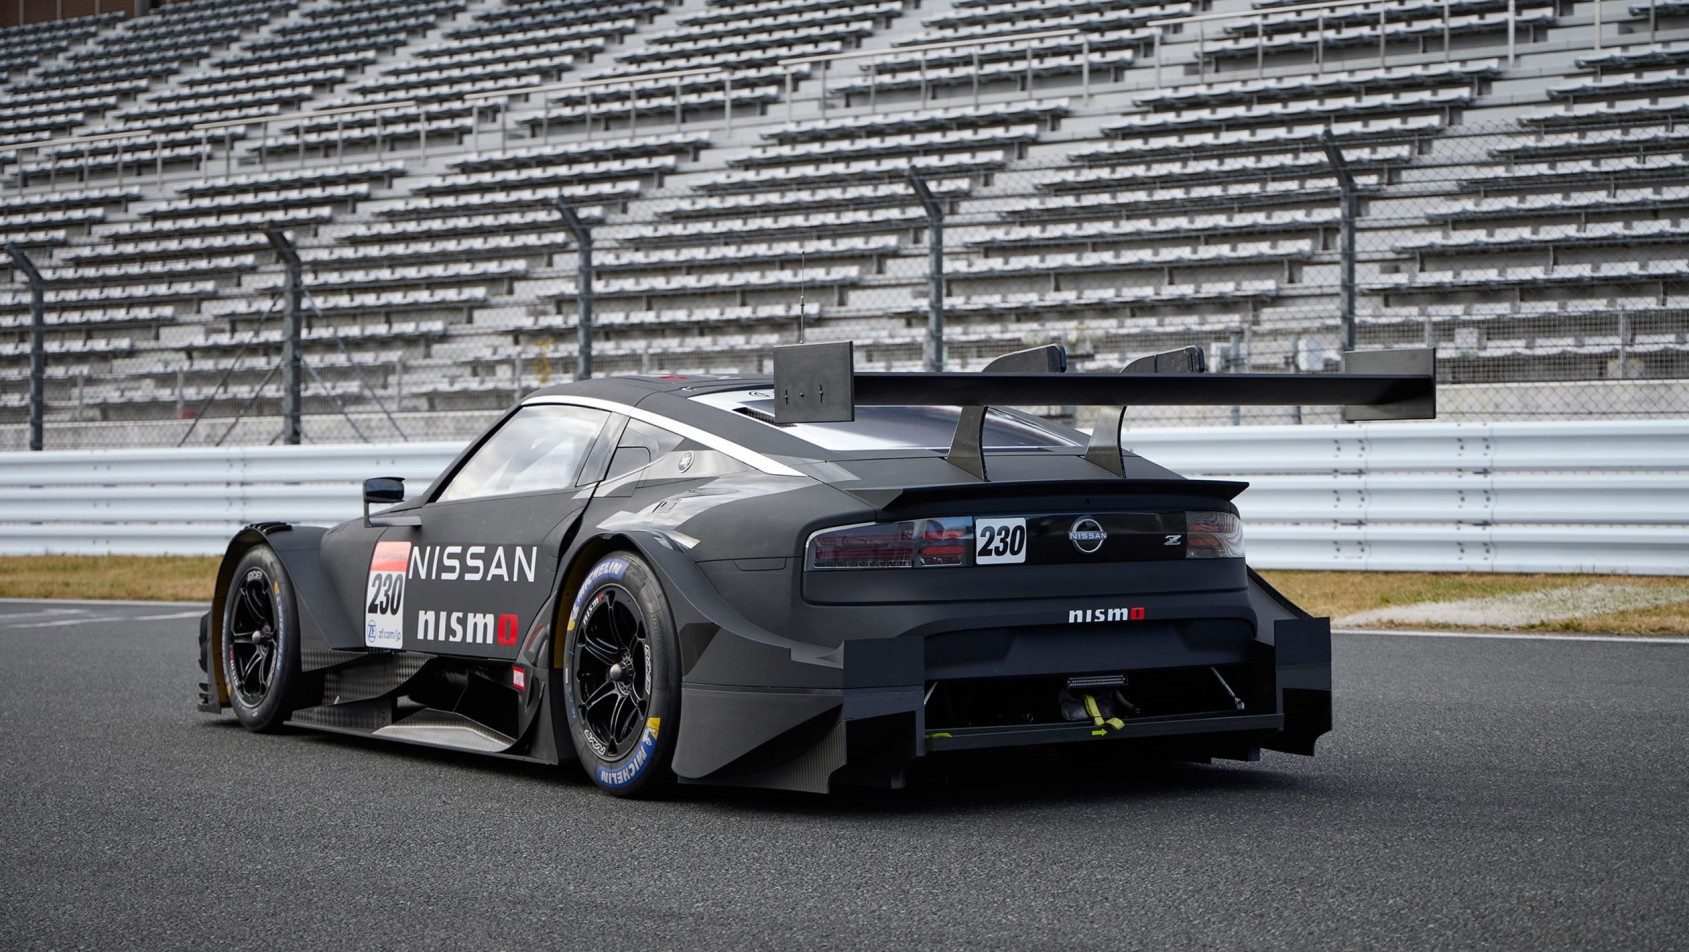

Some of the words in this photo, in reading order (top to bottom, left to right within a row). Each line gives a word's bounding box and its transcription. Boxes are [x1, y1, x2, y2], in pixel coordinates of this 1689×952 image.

[978, 525, 1026, 557] 230
[1069, 531, 1107, 541] NISSAN
[1164, 535, 1182, 546] Z
[408, 546, 538, 582] NISSAN
[368, 573, 404, 616] 230
[577, 561, 623, 602] MICHELIN
[583, 593, 605, 624] nismo
[1068, 607, 1145, 623] nismo
[417, 610, 519, 646] nismo
[600, 746, 648, 785] MICHELIN
